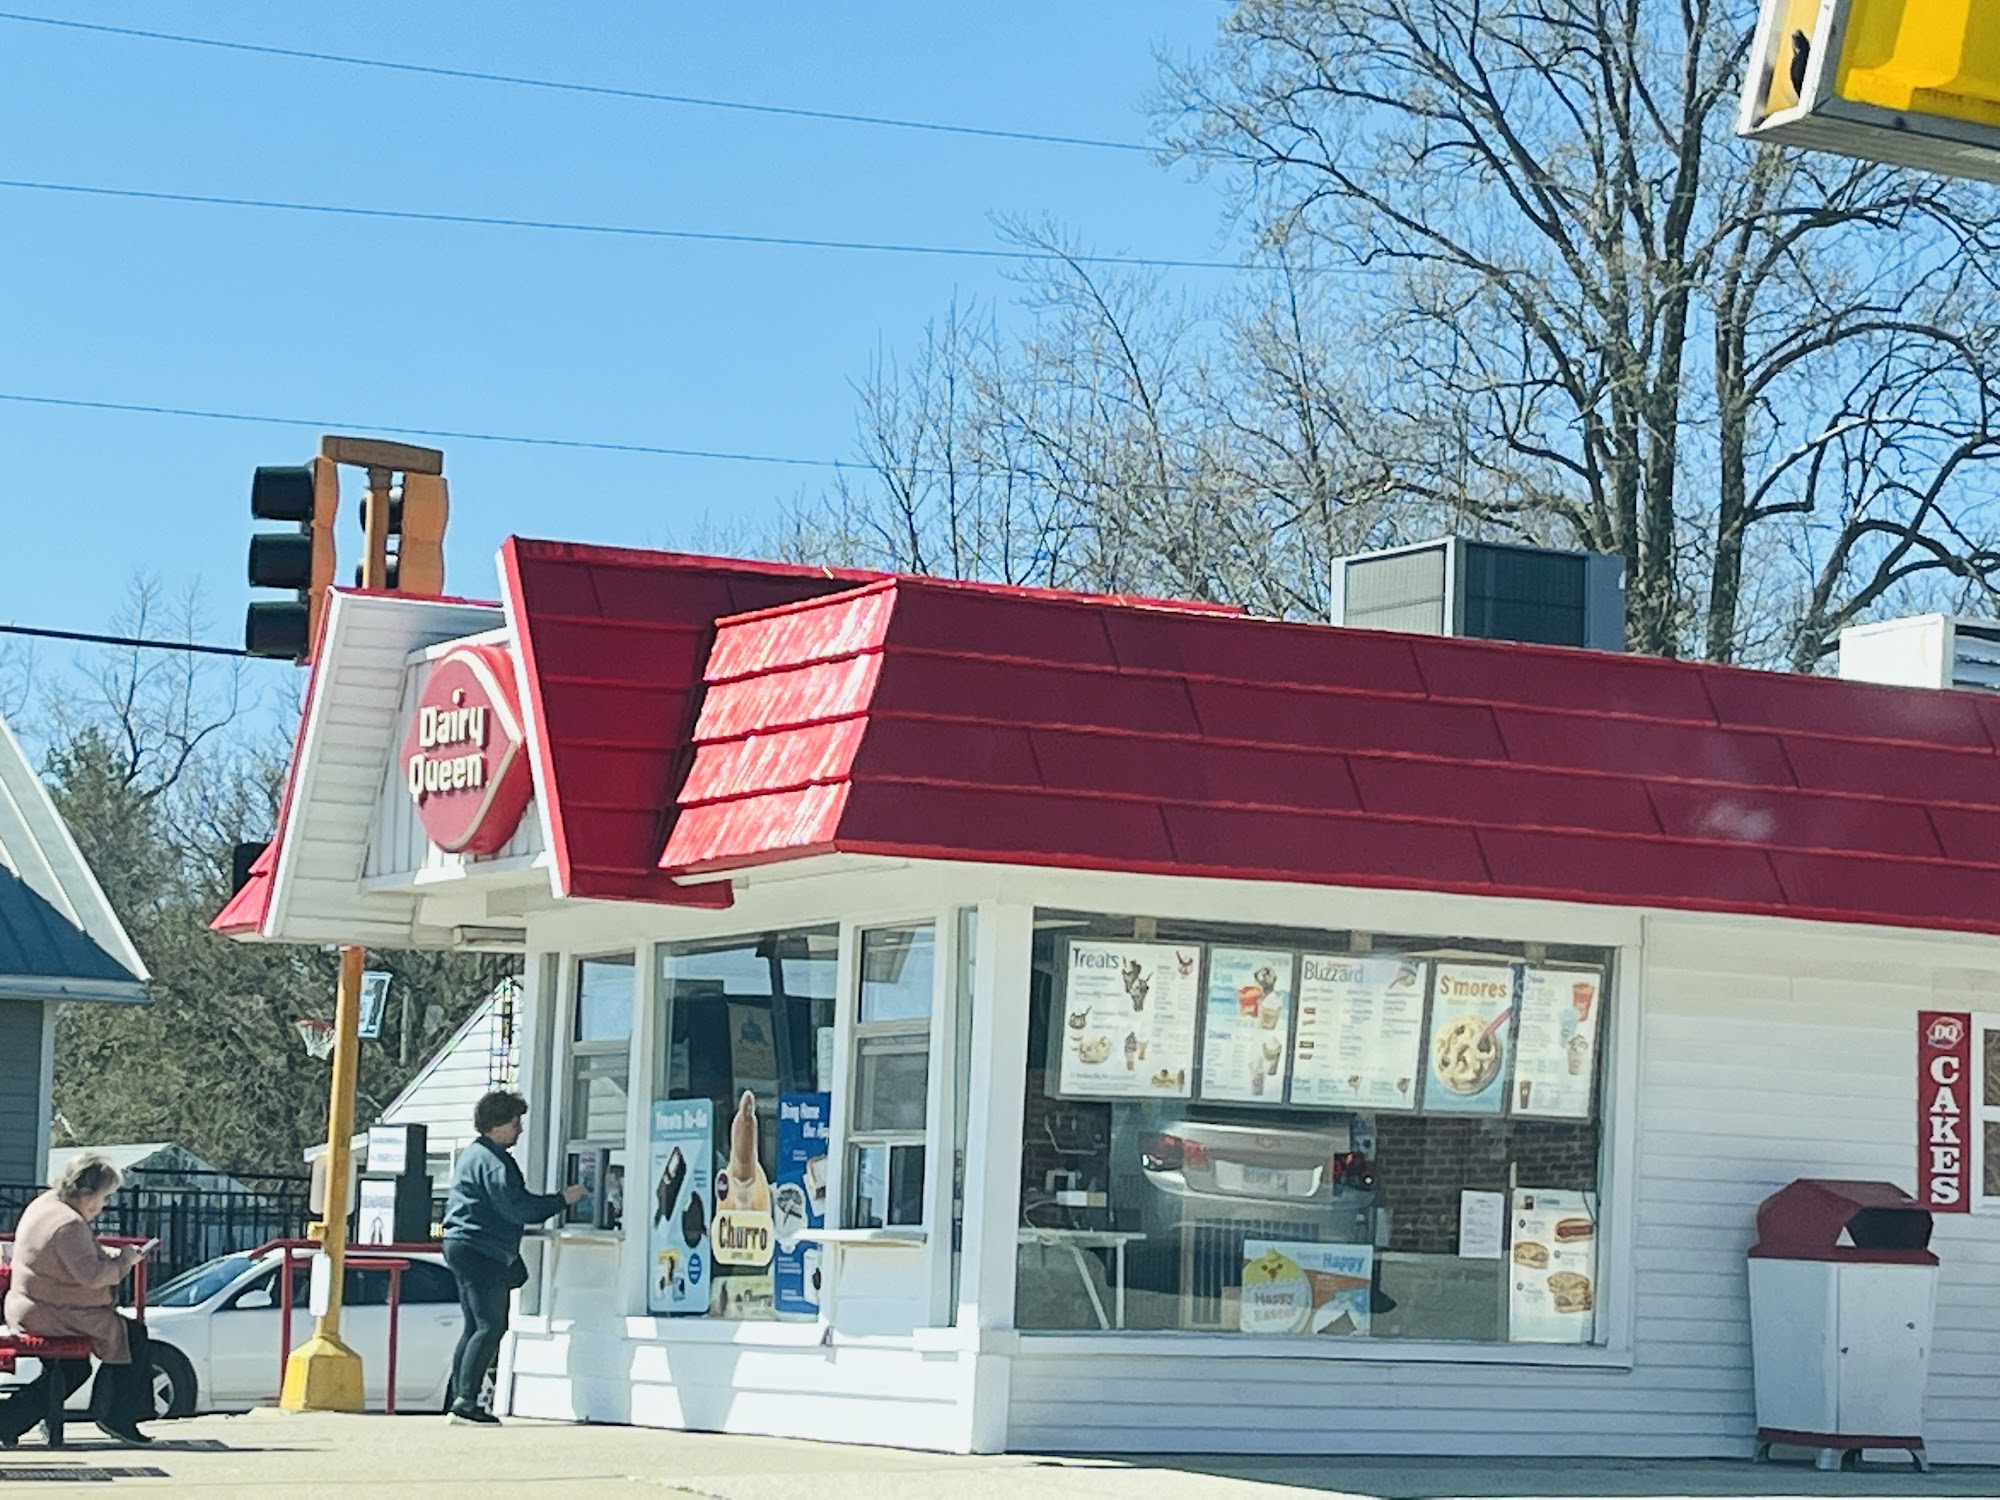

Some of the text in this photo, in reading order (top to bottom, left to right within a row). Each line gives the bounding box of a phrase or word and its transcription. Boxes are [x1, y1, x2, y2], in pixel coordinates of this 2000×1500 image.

[418, 688, 487, 747] Dairy
[408, 753, 484, 803] Queen
[1072, 947, 1120, 969] Treats
[1304, 960, 1364, 983] Blizzard
[1439, 975, 1508, 998] S'mores
[1932, 1024, 1957, 1042] DQ
[1929, 1055, 1961, 1204] CAKES
[719, 1216, 767, 1251] Churro
